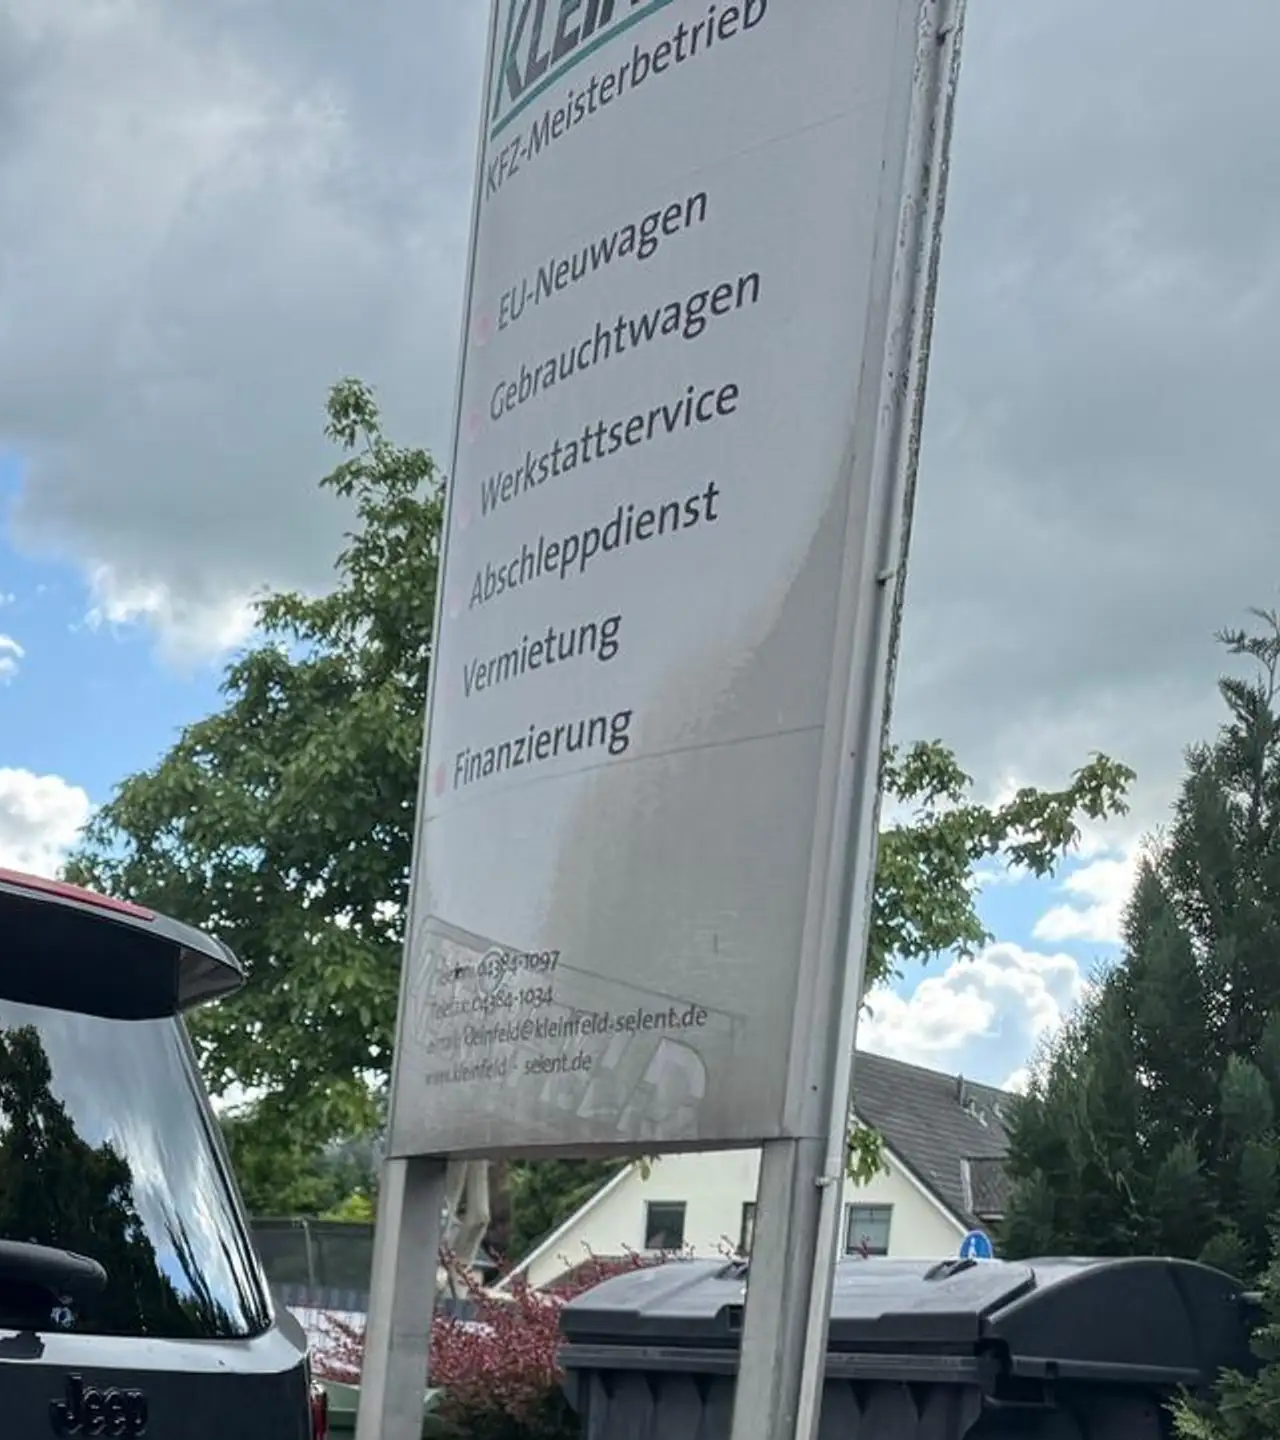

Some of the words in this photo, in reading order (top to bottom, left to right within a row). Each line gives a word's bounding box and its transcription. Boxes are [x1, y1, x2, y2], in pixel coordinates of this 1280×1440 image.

[485, 0, 768, 201] KFZ-Meisterbetrieb
[496, 189, 708, 333] EU-Neuwagen
[489, 269, 761, 422] Gebrauchtwagen
[480, 380, 739, 518] Werkstattservice
[467, 480, 720, 611] Abschleppdienst
[462, 612, 622, 699] Vermietung
[453, 708, 633, 791] Finanzierung
